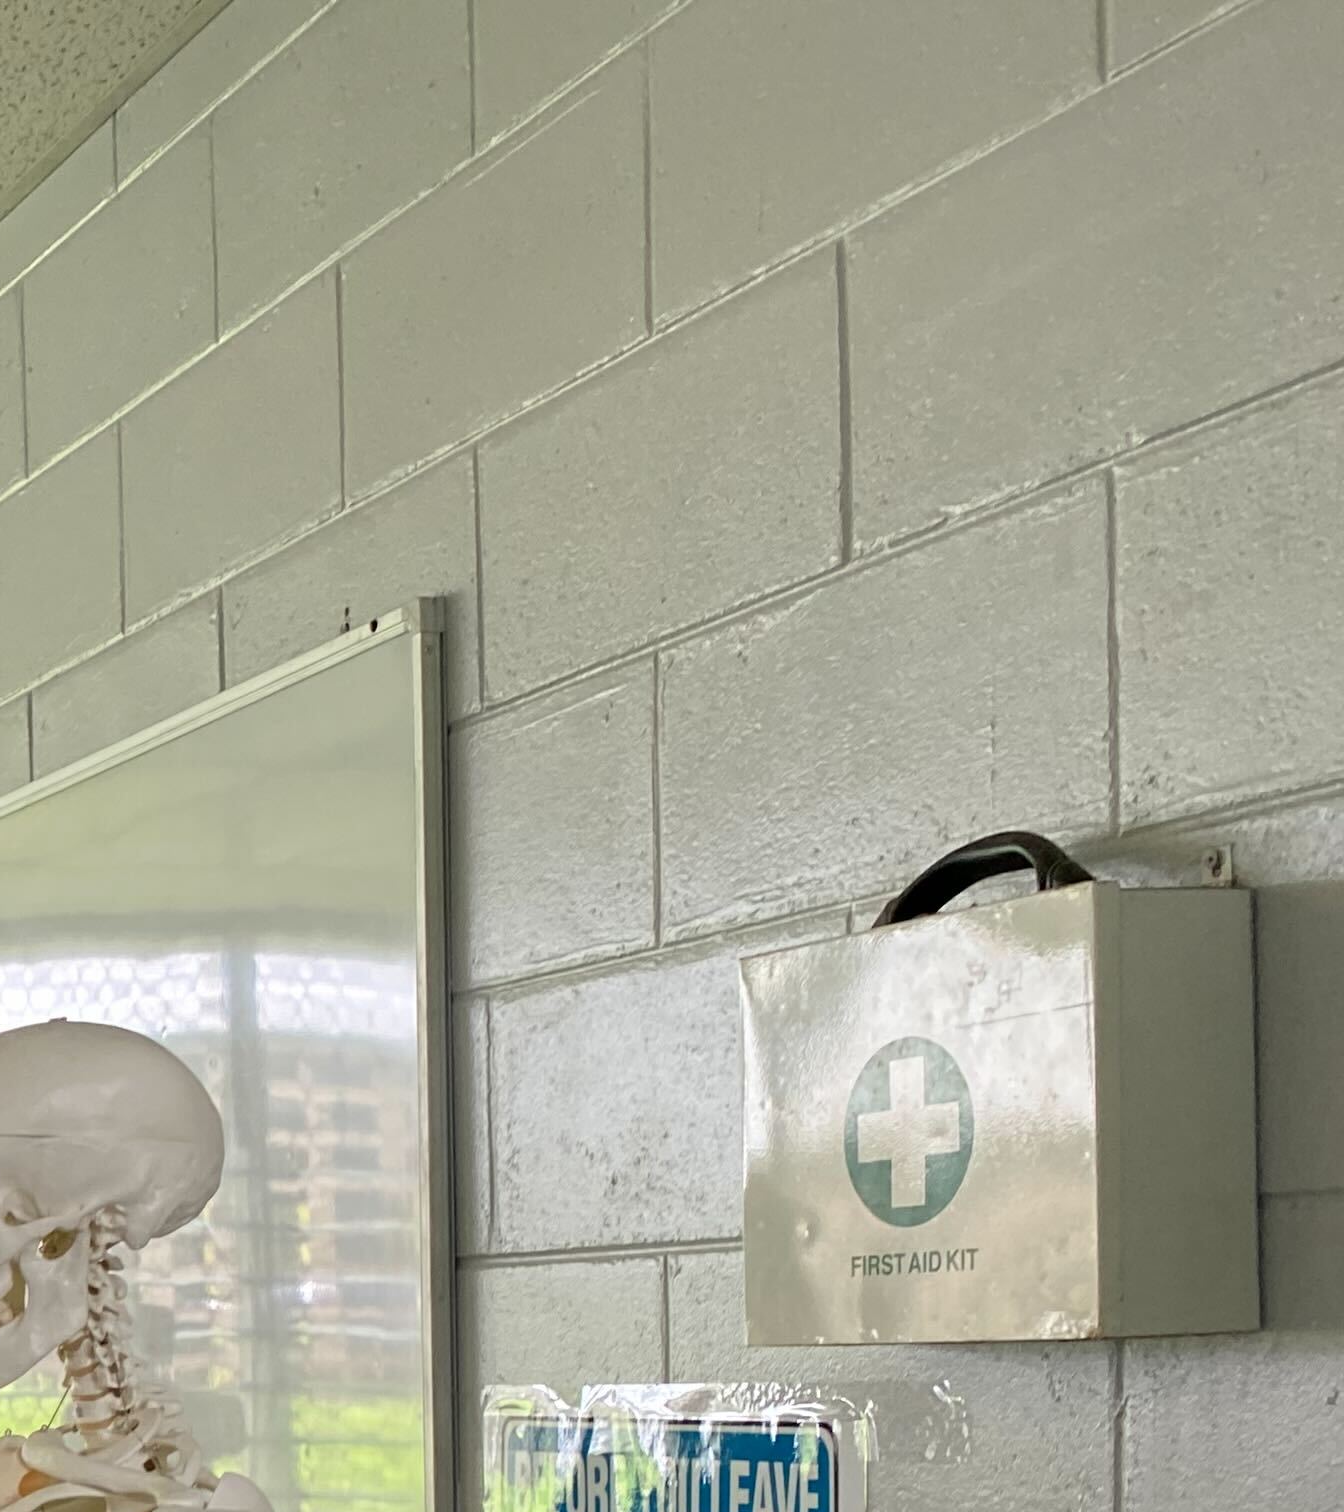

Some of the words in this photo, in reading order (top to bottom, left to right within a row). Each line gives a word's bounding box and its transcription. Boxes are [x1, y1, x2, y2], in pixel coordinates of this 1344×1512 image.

[850, 1253, 906, 1278] FIRST
[908, 1249, 942, 1274] AID
[946, 1247, 979, 1272] KIT
